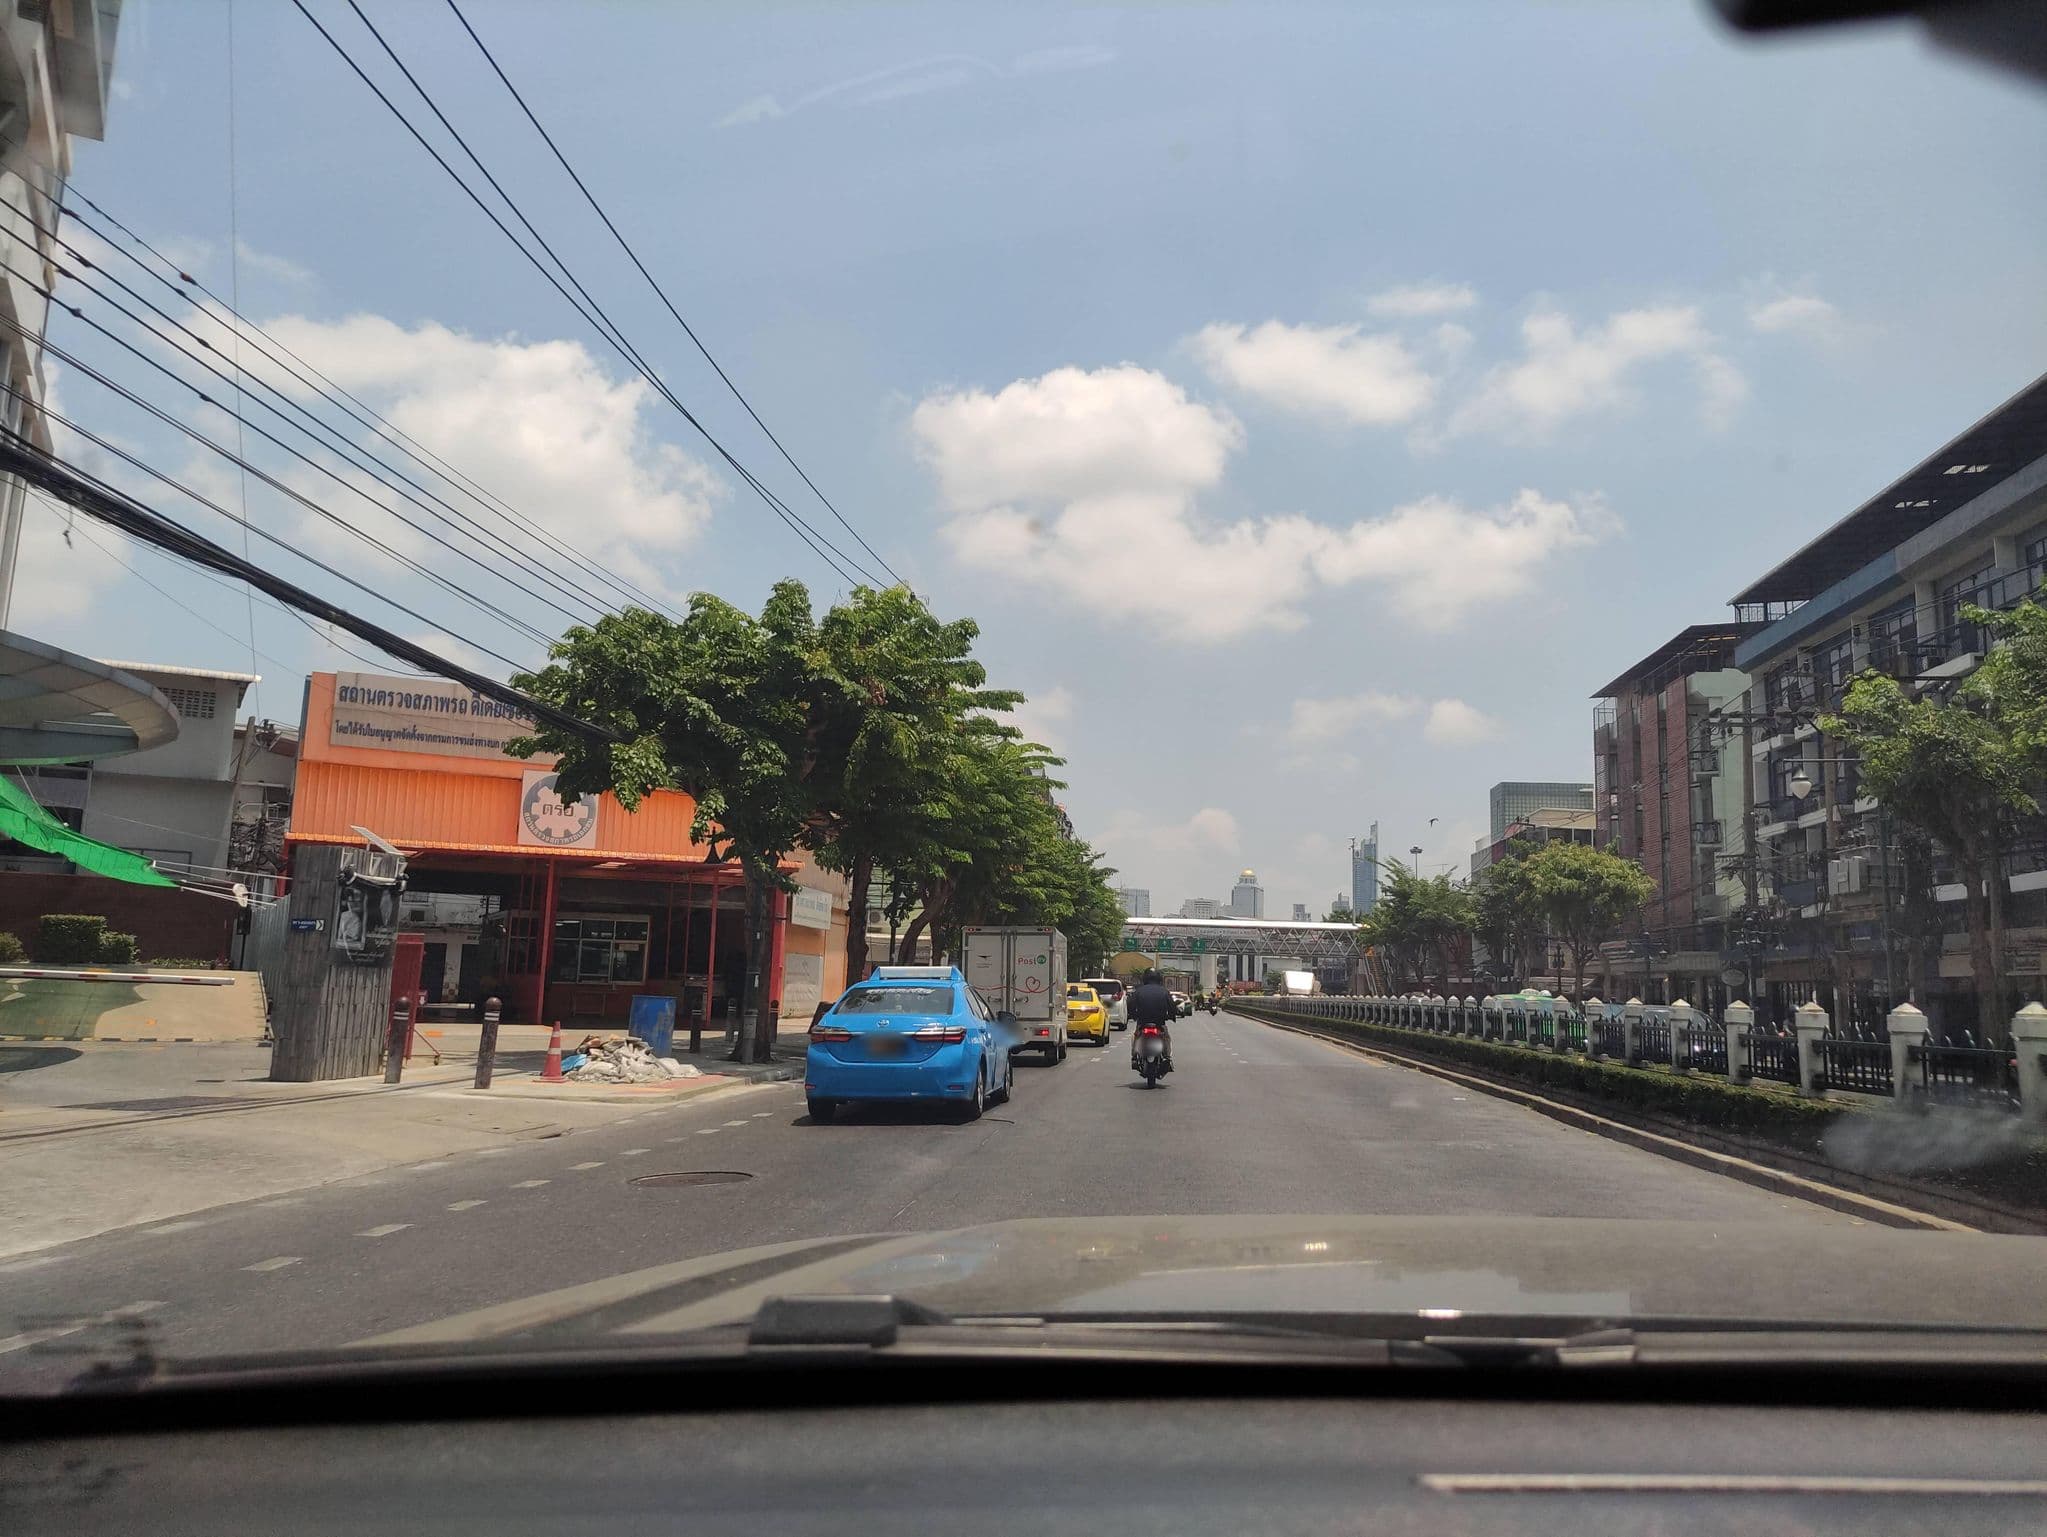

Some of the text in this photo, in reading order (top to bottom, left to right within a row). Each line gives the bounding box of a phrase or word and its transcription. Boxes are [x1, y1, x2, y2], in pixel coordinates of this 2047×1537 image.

[339, 685, 467, 715] สถานตรวจสภาพรถ
